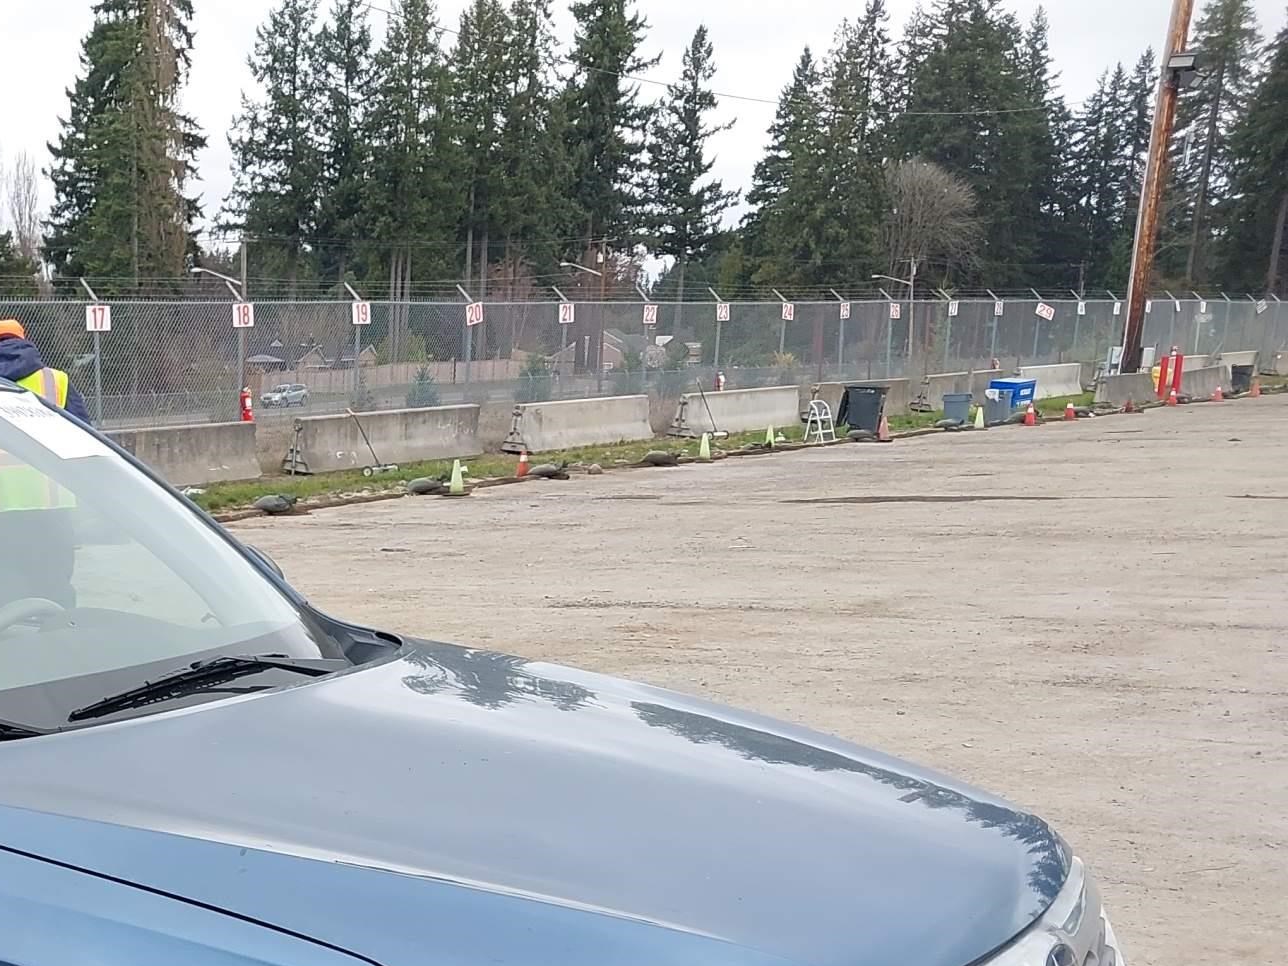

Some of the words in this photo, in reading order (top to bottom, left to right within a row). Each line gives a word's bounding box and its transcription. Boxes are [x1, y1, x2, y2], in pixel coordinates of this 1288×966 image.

[92, 307, 104, 329] 17
[237, 304, 250, 325] 18
[356, 303, 367, 322] 19
[468, 303, 481, 323] 20
[562, 305, 572, 321] 21
[645, 306, 656, 321] 22
[718, 304, 728, 320] 23
[783, 304, 793, 319] 24
[1038, 304, 1052, 319] 29
